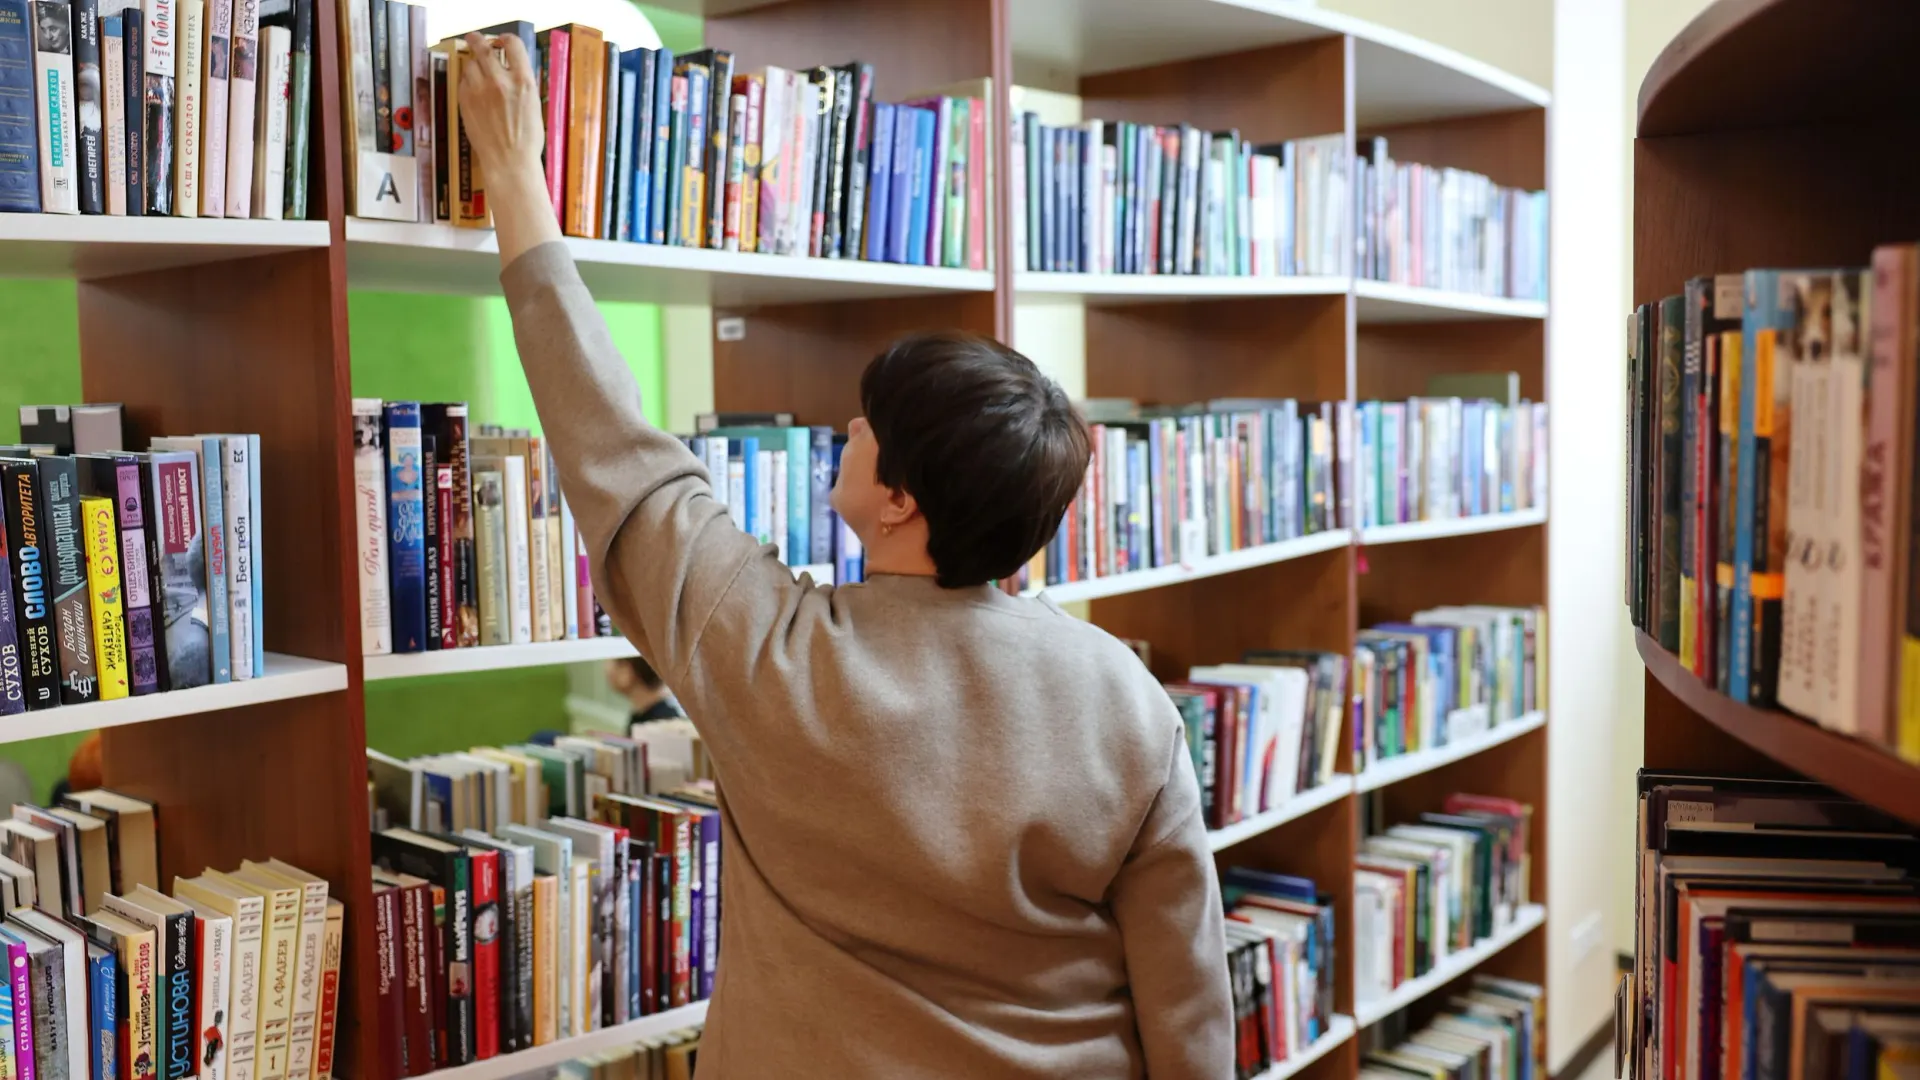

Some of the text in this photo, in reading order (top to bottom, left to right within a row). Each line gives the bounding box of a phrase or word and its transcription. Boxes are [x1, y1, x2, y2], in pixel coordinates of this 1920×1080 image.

[186, 14, 196, 76] ТРИПТИХ
[52, 112, 62, 166] ВЕНИАМИН
[184, 94, 194, 198] САША СОКОЛОВ
[376, 172, 401, 204] А
[165, 475, 177, 544] Александр Терехов
[178, 467, 191, 549] КАМЕННЫЙ МОСТ
[17, 473, 46, 620] СЛОВО АВТОРИТЕТА
[95, 510, 114, 576] СЛАВА СЭ
[125, 537, 138, 602] ОТЦЕУБИЙЦА
[235, 516, 248, 583] Бес тебя
[27, 627, 39, 677] Евгений
[38, 625, 51, 676] СУХОВ
[61, 608, 76, 652] Богдан
[72, 600, 89, 665] Сушинский
[102, 611, 116, 671] САНТЕХНИК
[3, 643, 21, 701] СУХОВ
[240, 951, 253, 1006] ФАДЕЕВ
[274, 939, 287, 993] ФАДЕЕВ
[302, 933, 316, 987] ФАДЕЕВ
[18, 974, 26, 1006] САША
[136, 942, 151, 1049] Устинова Астахов
[20, 1010, 29, 1051] СТРАНА
[169, 969, 190, 1077] УСТИНОВА
[294, 1046, 305, 1064] 2
